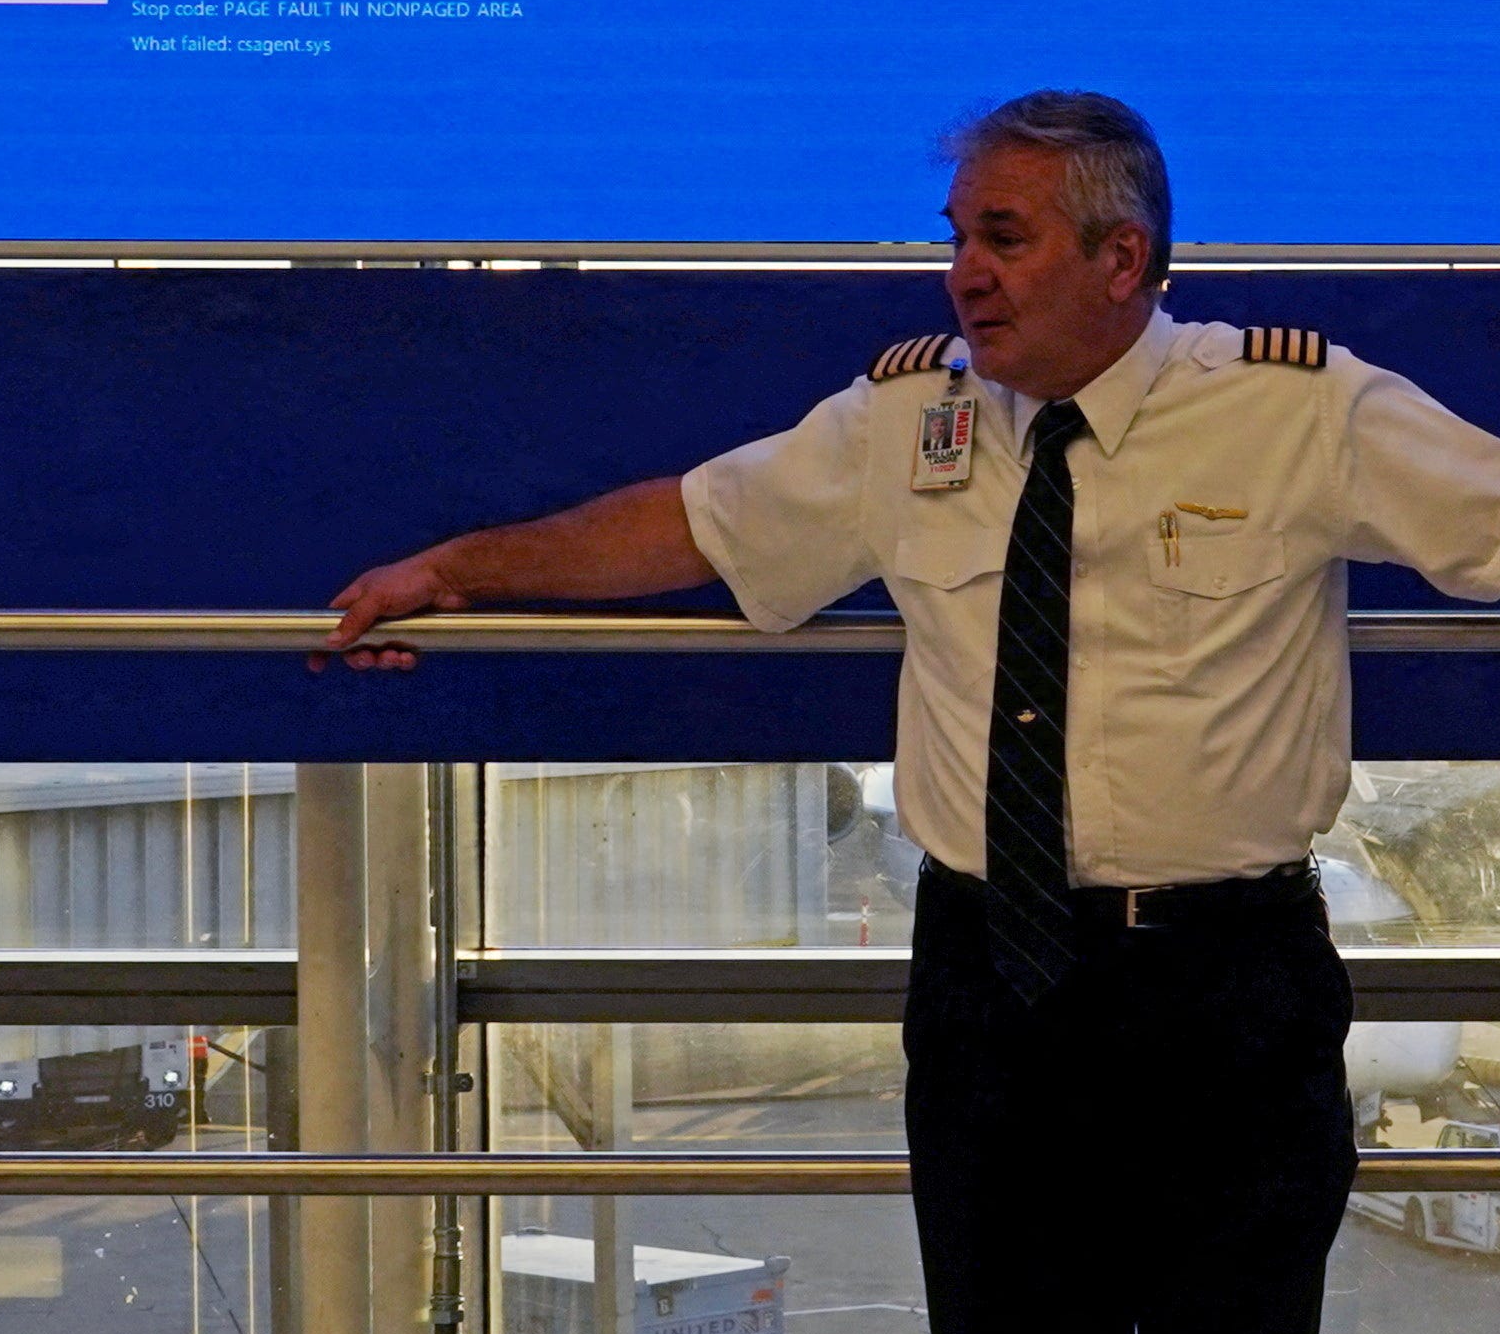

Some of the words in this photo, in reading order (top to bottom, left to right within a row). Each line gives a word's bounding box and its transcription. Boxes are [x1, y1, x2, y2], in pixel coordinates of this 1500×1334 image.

[131, 0, 171, 21] Stop
[174, 0, 219, 17] code:
[131, 35, 177, 52] What
[181, 34, 232, 52] failed:
[954, 410, 971, 446] CREW
[144, 1092, 176, 1108] 310
